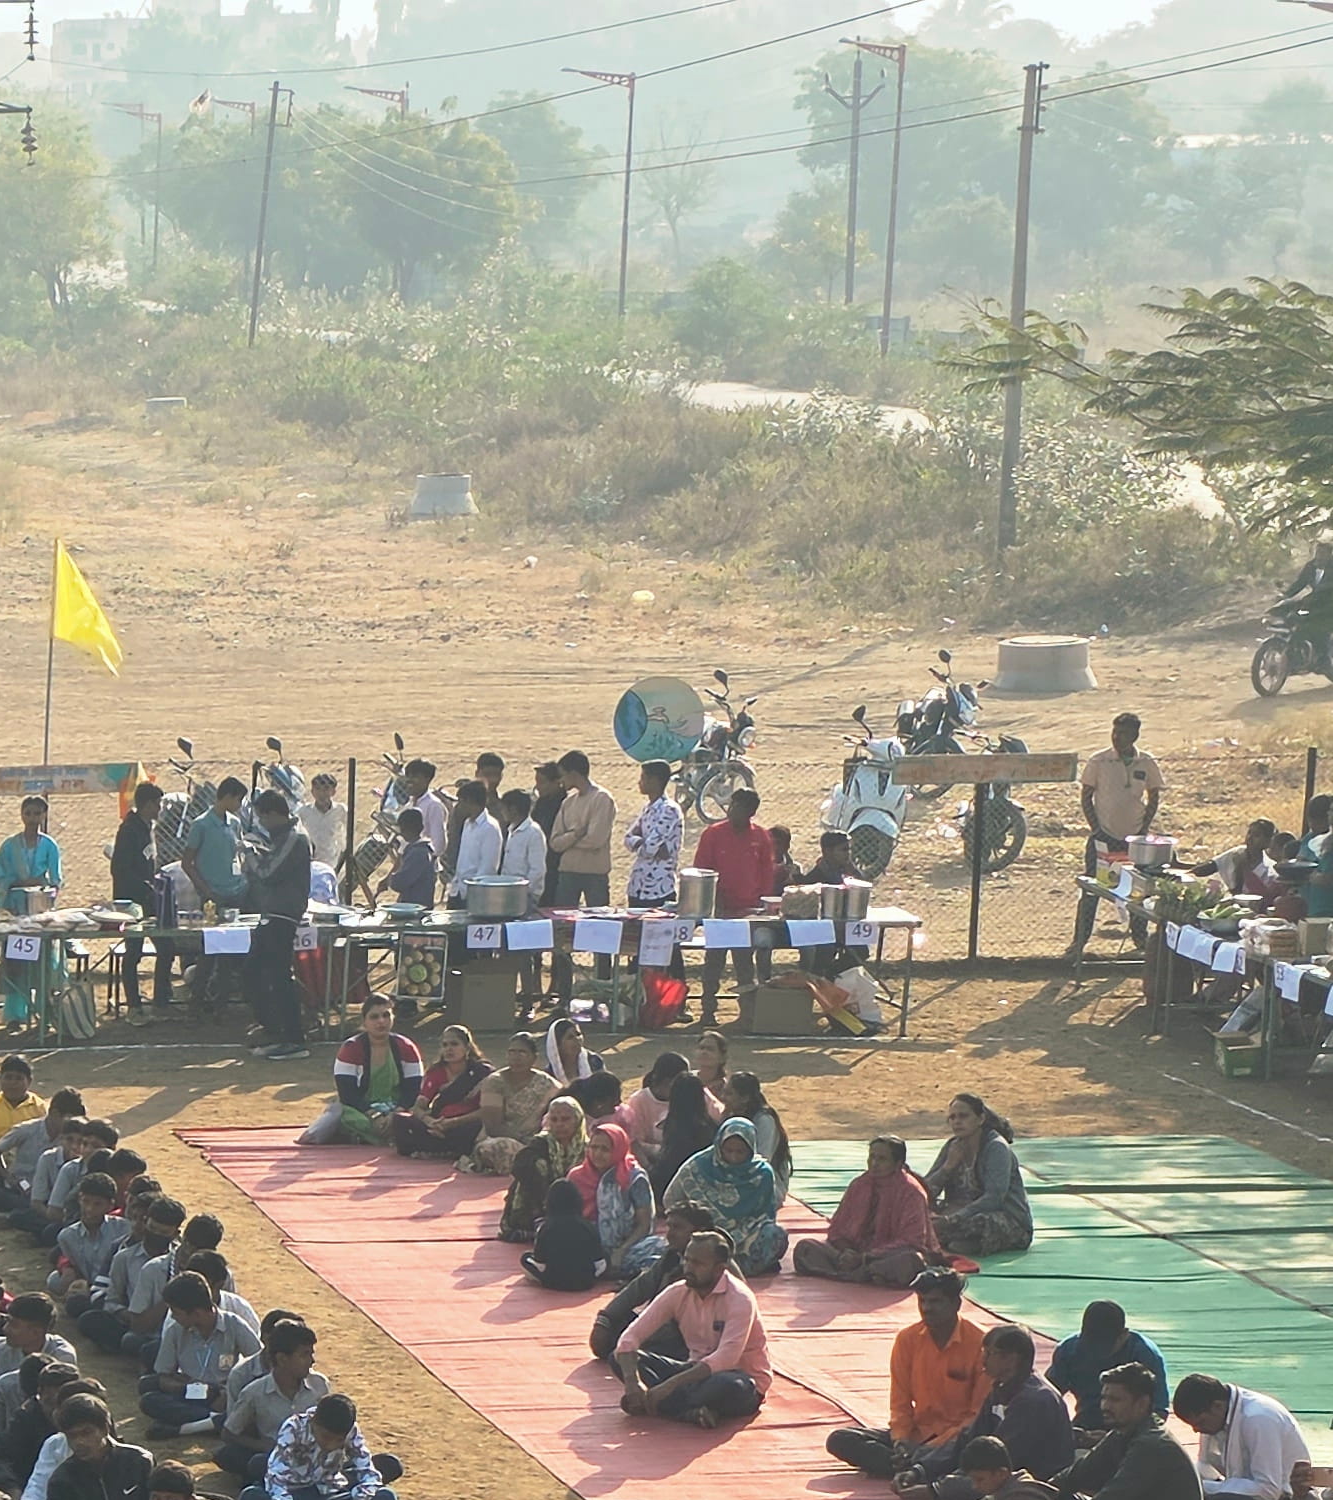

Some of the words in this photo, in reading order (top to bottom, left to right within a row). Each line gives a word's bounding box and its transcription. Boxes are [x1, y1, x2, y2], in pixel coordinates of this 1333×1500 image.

[473, 926, 495, 941] 47
[852, 922, 872, 937] 49
[14, 937, 34, 952] 45
